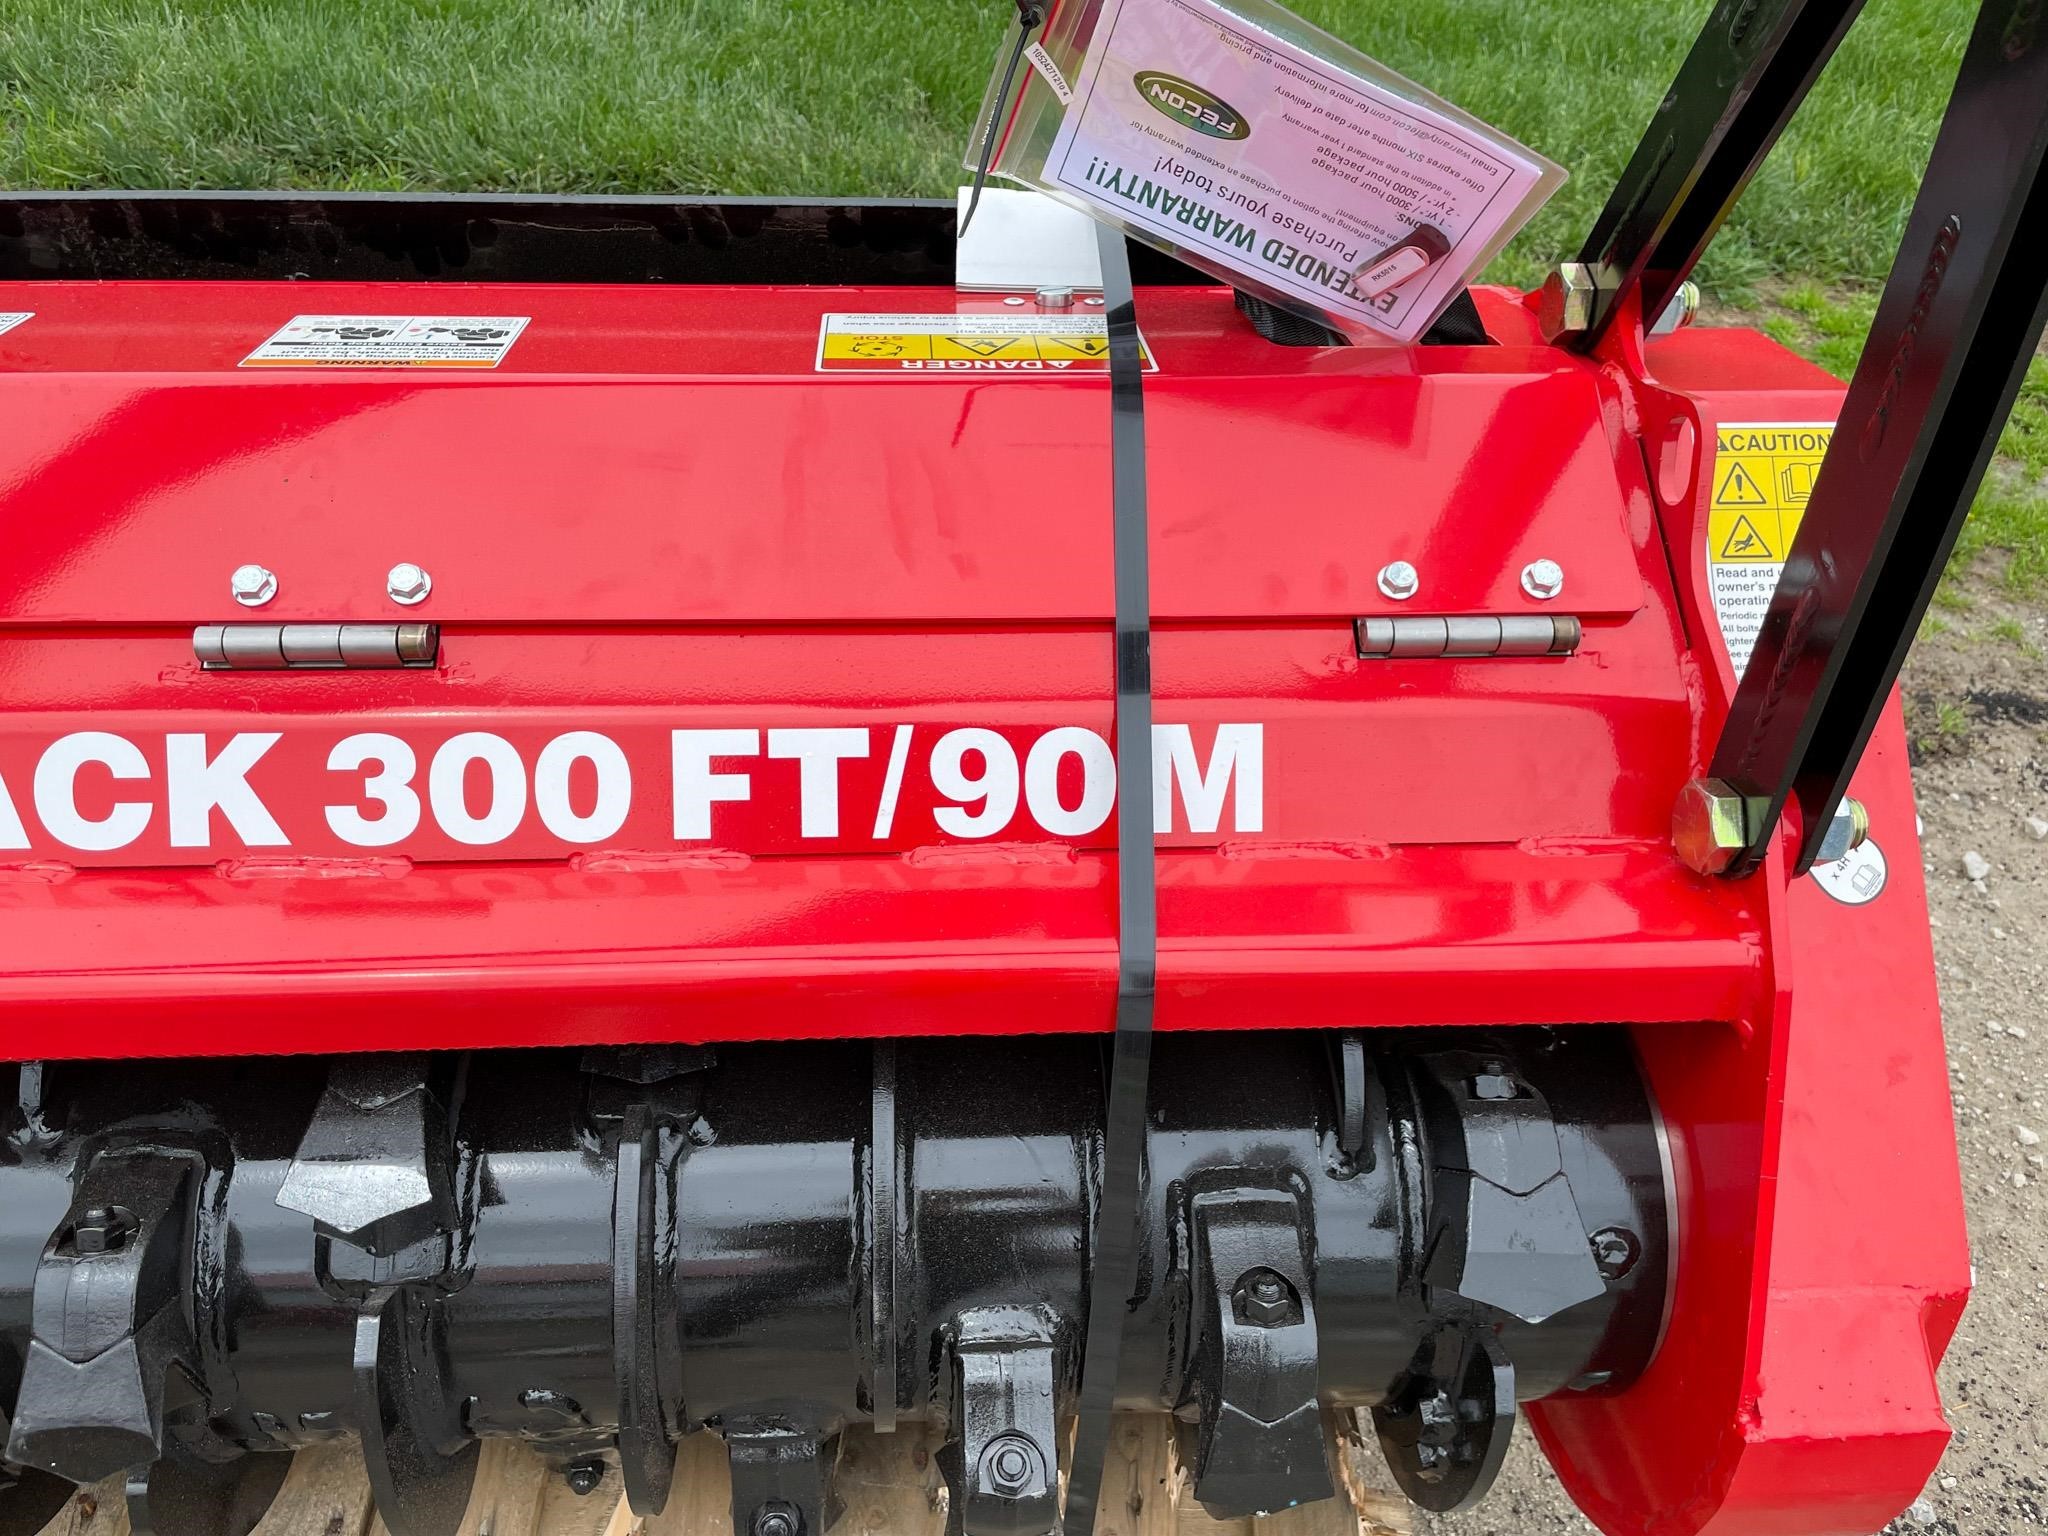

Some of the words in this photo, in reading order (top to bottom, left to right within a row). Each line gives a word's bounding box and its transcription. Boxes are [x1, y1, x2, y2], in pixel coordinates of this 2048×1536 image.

[1215, 31, 1252, 56] pricing.
[1252, 51, 1272, 66] and
[1272, 60, 1328, 93] information
[1328, 87, 1354, 104] more
[1150, 82, 1237, 134] FECON
[1312, 104, 1323, 115] of
[1353, 100, 1369, 113] for
[1129, 119, 1143, 131] for
[1280, 111, 1321, 136] warranty
[1323, 110, 1346, 126] date
[1143, 125, 1185, 150] warranty
[1320, 130, 1340, 145] year
[1346, 121, 1370, 138] after
[1370, 132, 1406, 155] months
[1183, 145, 1226, 171] extended
[1314, 143, 1365, 174] package
[1346, 144, 1384, 167] standard
[1405, 148, 1425, 163] SIX
[1152, 152, 1215, 196] today!
[1226, 166, 1238, 176] an
[1309, 155, 1359, 186] package
[1384, 162, 1400, 174] the
[1400, 169, 1410, 178] to
[1425, 156, 1461, 179] expires
[1471, 156, 1498, 176] Email
[1238, 171, 1281, 197] purchase
[1364, 168, 1392, 187] hour
[1460, 175, 1485, 194] Offer
[1281, 192, 1291, 201] to
[1359, 180, 1386, 199] hour
[1390, 180, 1419, 200] 5000
[1084, 156, 1259, 252] WARRANTY!!
[1215, 182, 1270, 218] yours
[1291, 197, 1320, 216] option
[1384, 192, 1412, 211] 3000
[1320, 211, 1336, 224] the
[1334, 207, 1386, 236] equipment!
[1268, 210, 1358, 263] Purchase
[1335, 218, 1371, 241] offering
[900, 360, 1042, 368] DANGER
[1729, 433, 1831, 451] CAUTION
[1716, 567, 1747, 578] Read
[1751, 567, 1774, 578] and
[1717, 581, 1765, 592] owner's
[1719, 595, 1770, 608] operatin
[1720, 611, 1758, 620] Periodic
[1722, 624, 1734, 633] All
[1726, 637, 1755, 647] ighten
[0, 731, 292, 852] CK
[325, 731, 632, 846] 300
[671, 725, 1118, 840] FT/90
[1151, 722, 1264, 834] M
